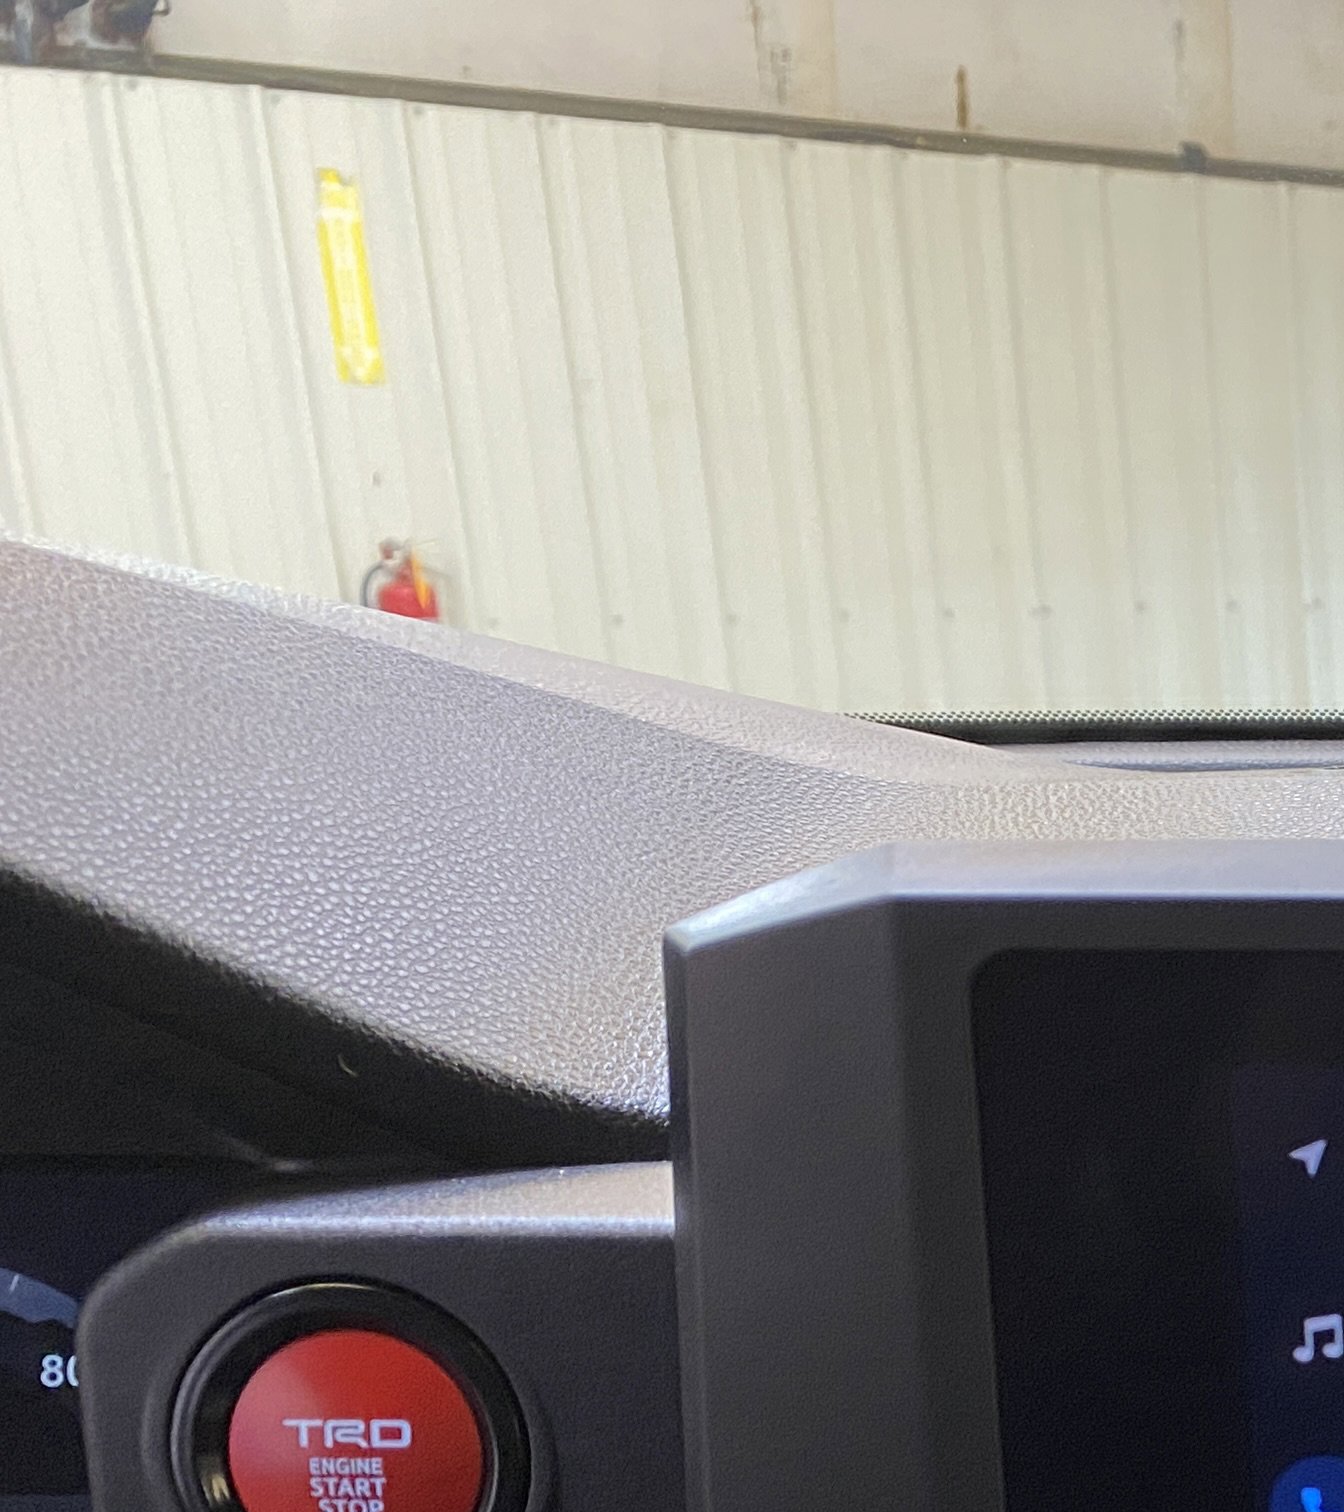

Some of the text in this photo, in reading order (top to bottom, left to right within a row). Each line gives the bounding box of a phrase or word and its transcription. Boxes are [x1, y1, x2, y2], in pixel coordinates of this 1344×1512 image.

[281, 1418, 412, 1449] TRD
[308, 1456, 384, 1476] ENGINE
[310, 1477, 387, 1498] START
